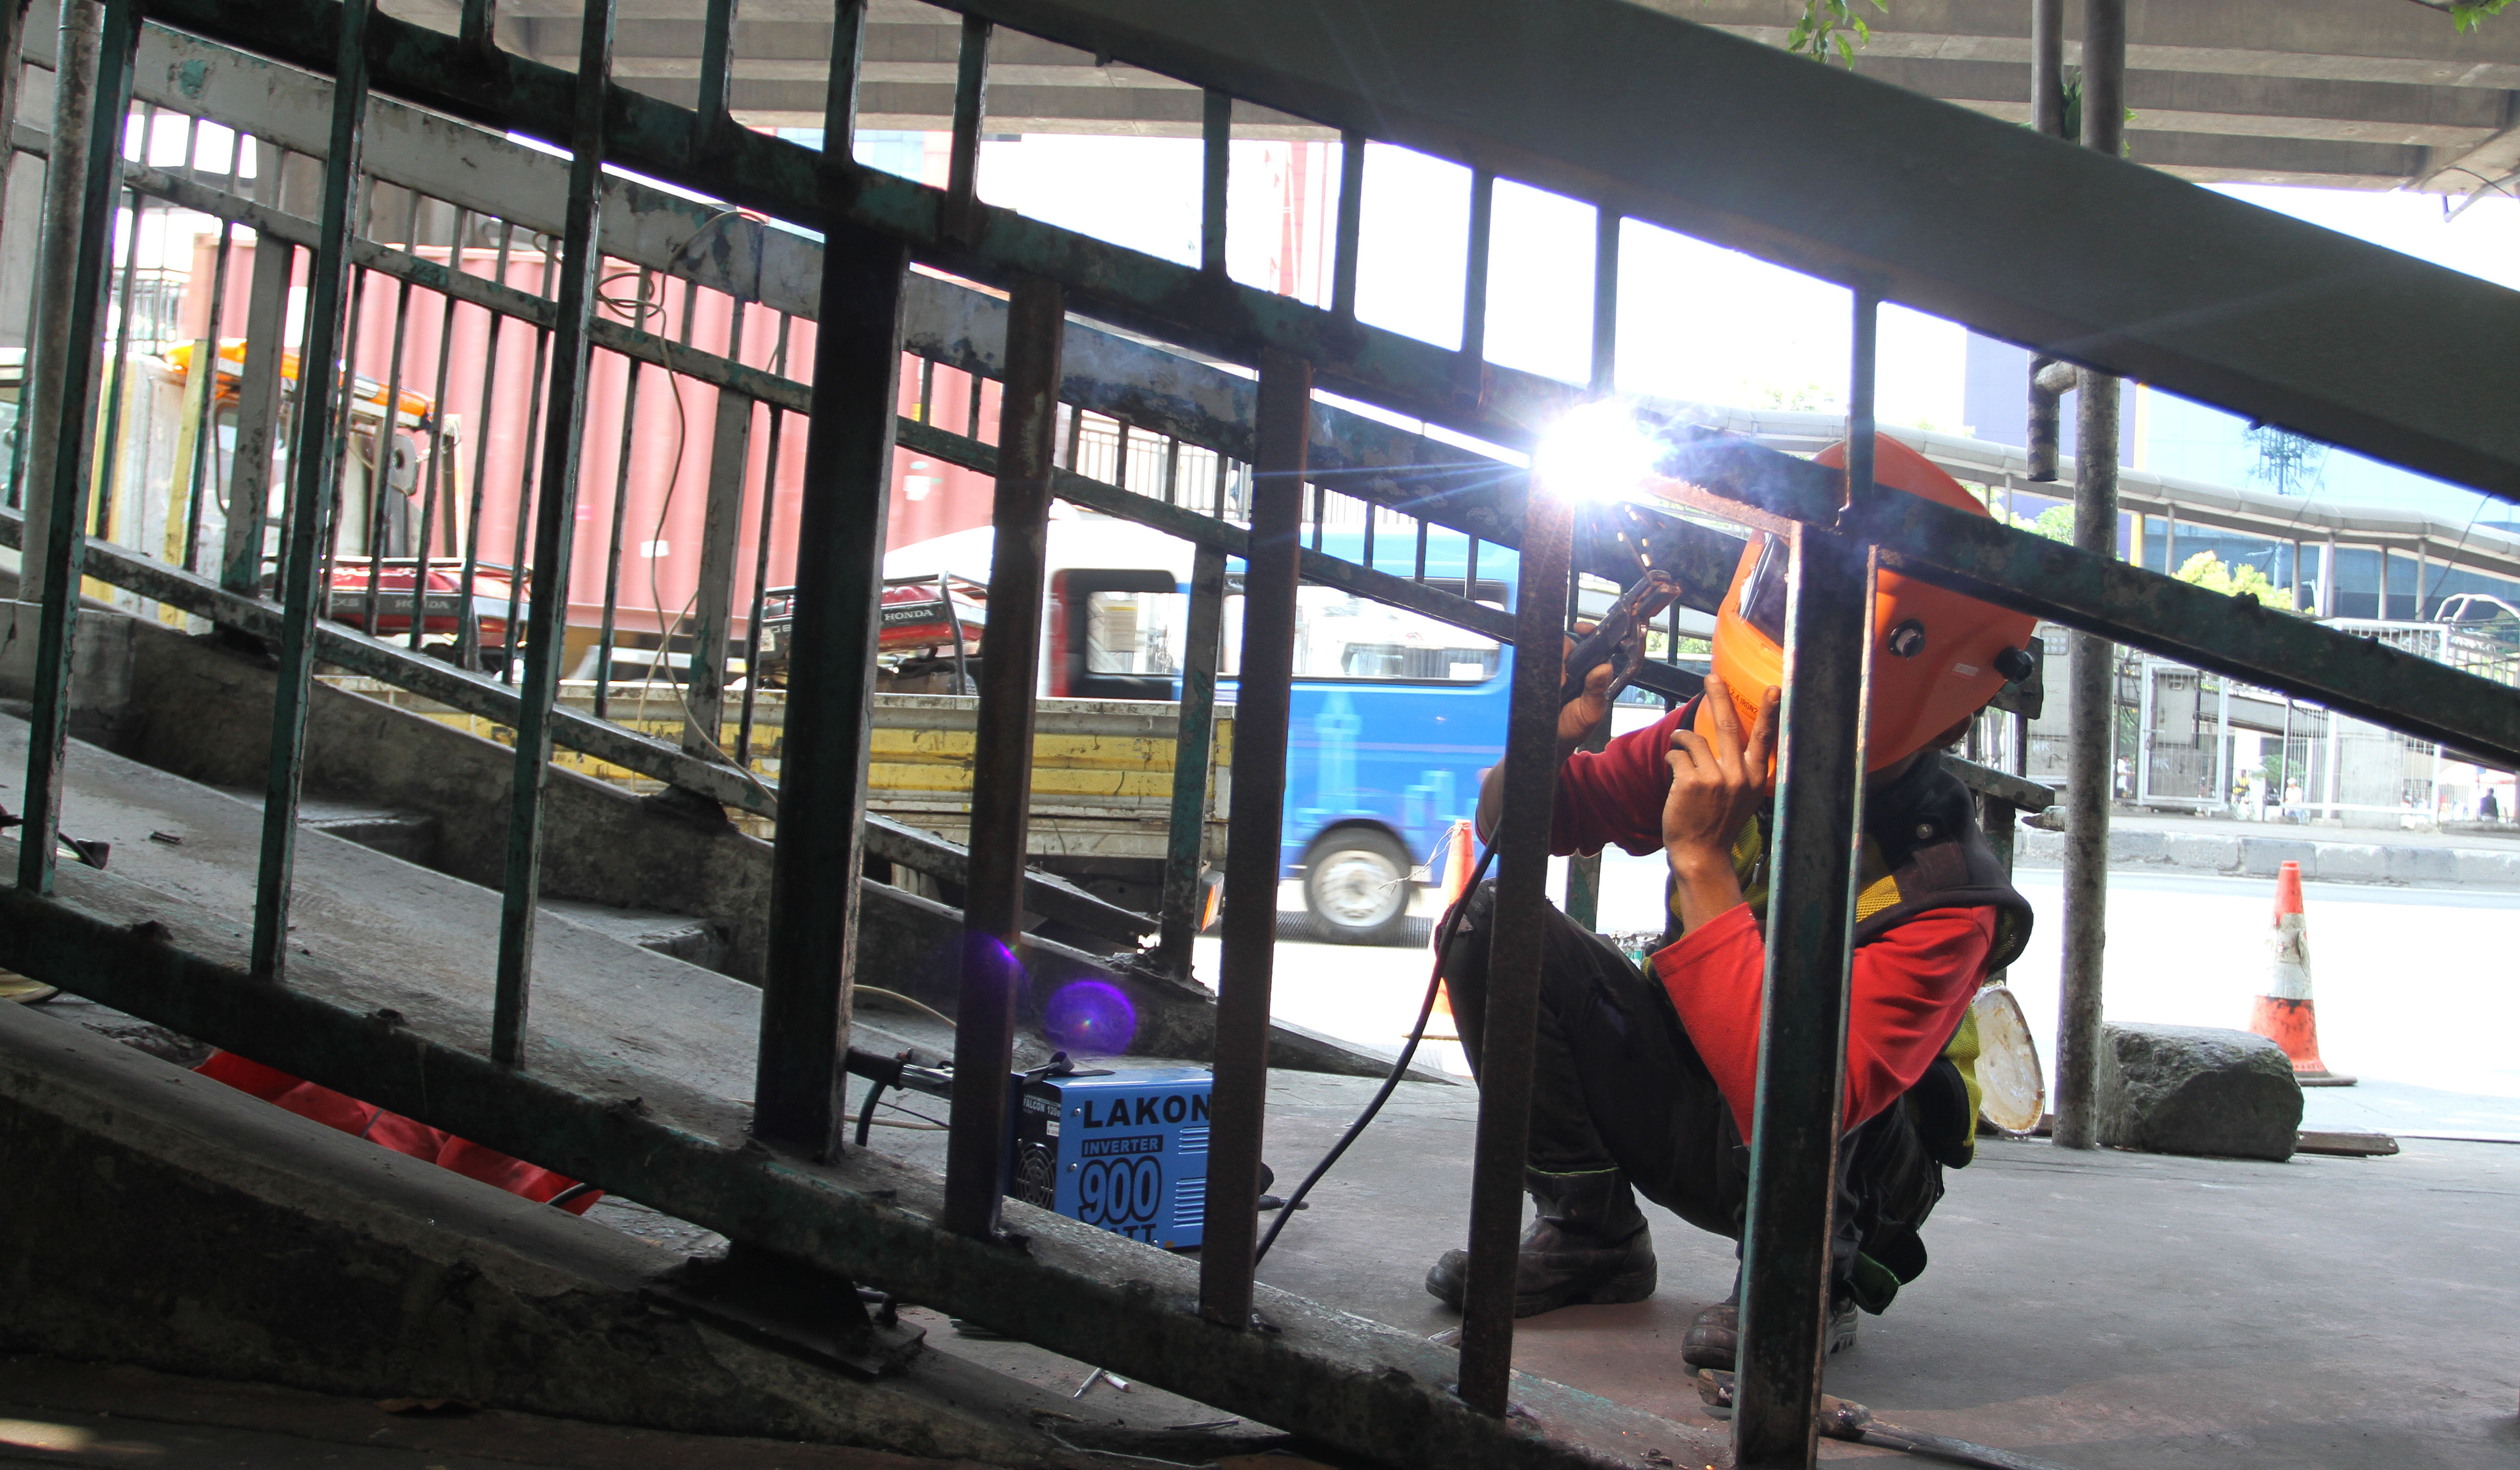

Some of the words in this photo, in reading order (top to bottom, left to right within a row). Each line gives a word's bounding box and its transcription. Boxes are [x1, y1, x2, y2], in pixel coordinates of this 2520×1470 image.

[395, 600, 450, 609] HODA
[884, 609, 933, 621] HONDA
[1023, 1098, 1045, 1112] FALCON
[1084, 1094, 1210, 1128] LAKON
[1084, 1138, 1159, 1155] INVERTER
[1078, 1155, 1162, 1226] 900
